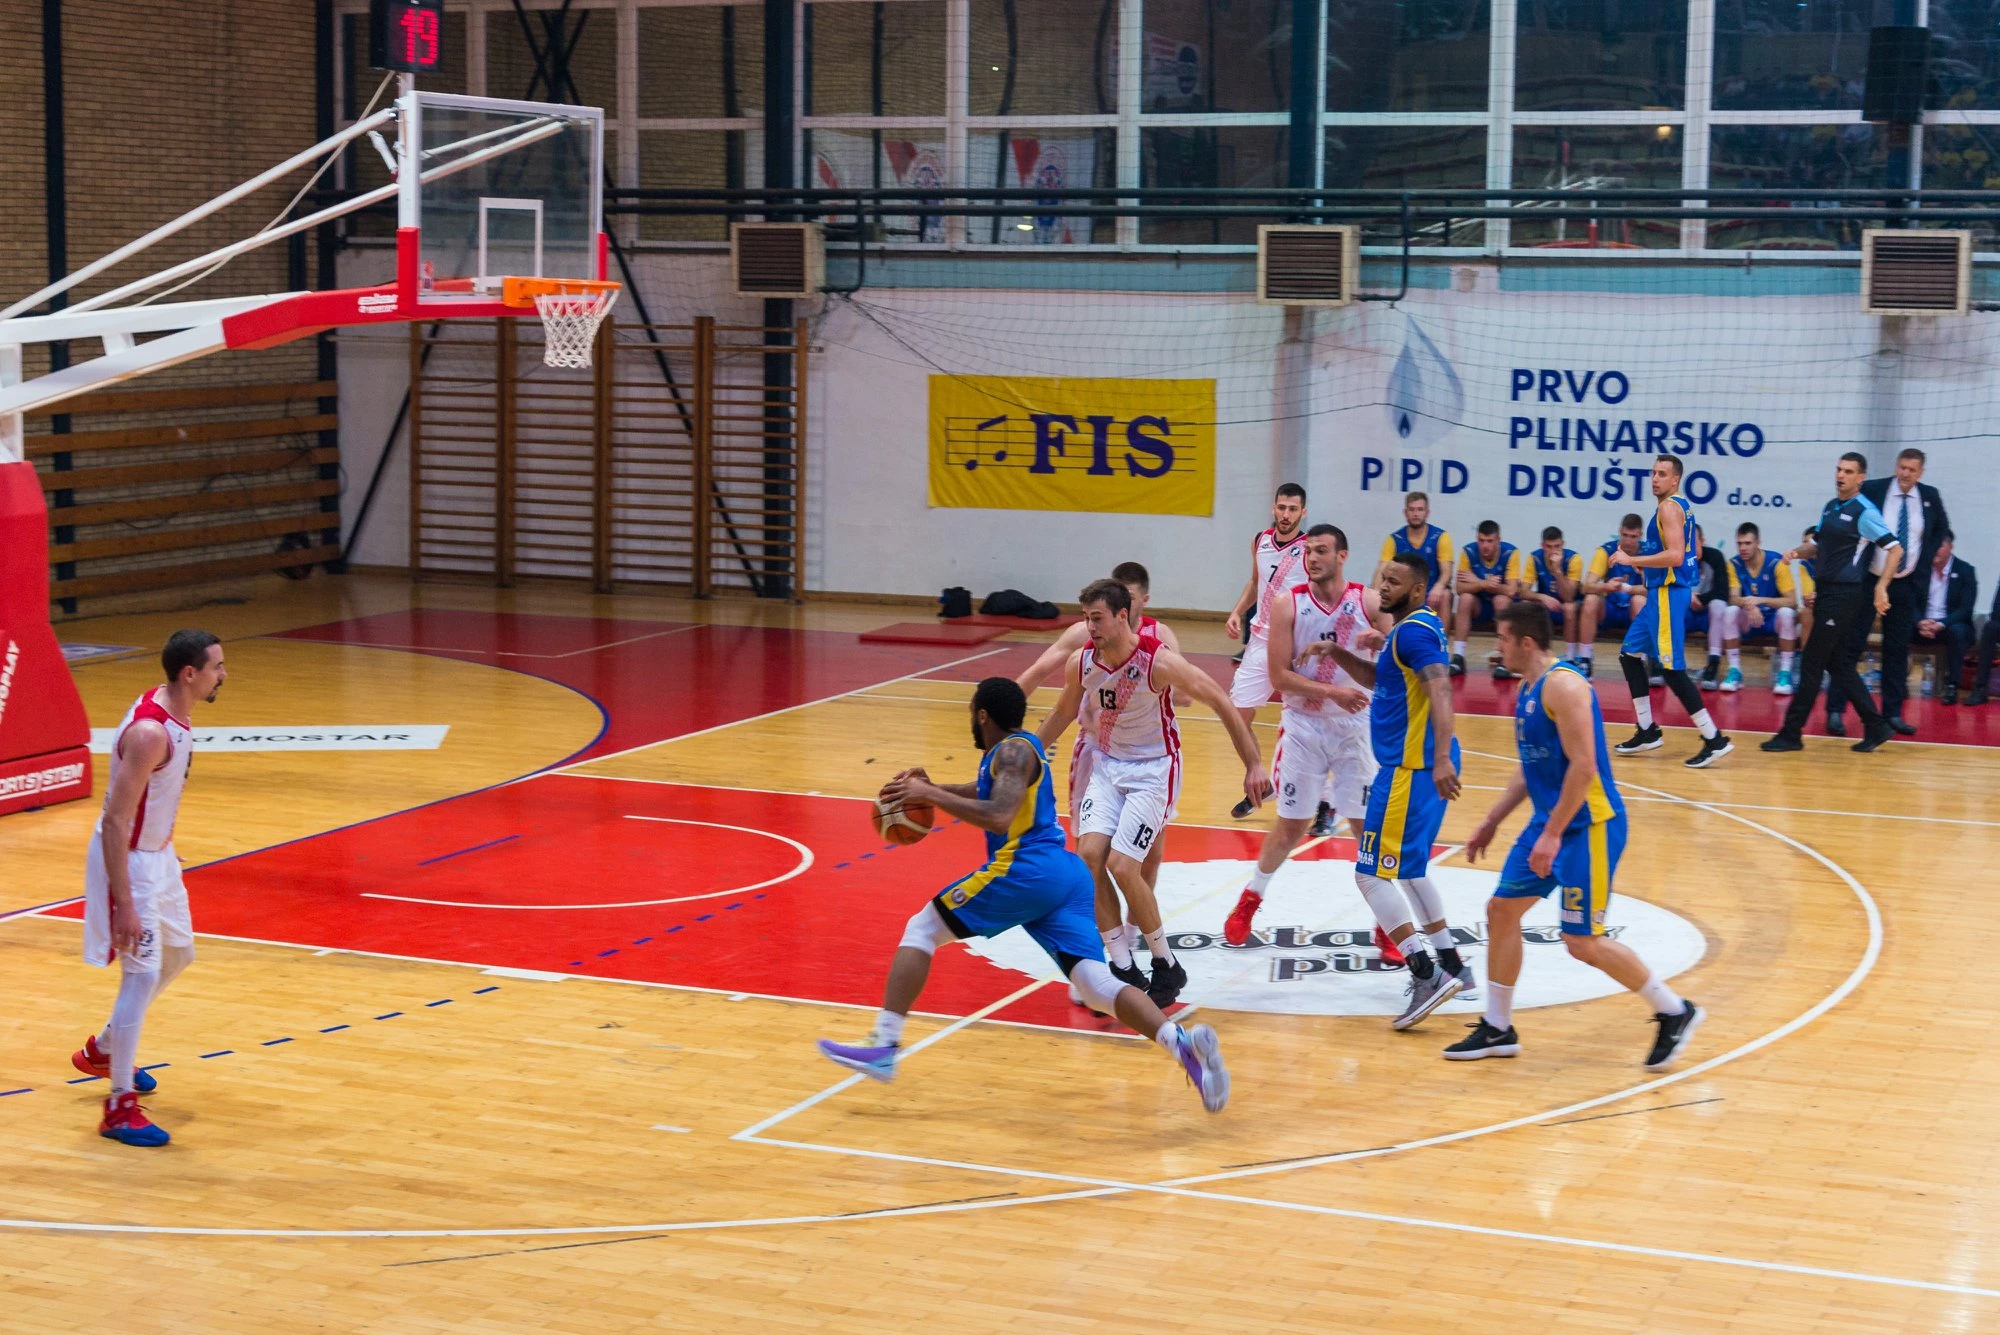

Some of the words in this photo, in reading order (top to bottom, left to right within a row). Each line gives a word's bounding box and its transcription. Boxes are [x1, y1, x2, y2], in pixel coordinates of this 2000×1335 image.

[400, 9, 438, 64] 19
[1511, 368, 1630, 405] PRVO
[1028, 413, 1175, 478] FIS
[1510, 416, 1764, 458] PLINARSKO
[1508, 458, 1718, 504] DRUŠTO
[1727, 487, 1792, 508] d.o.o.
[1268, 564, 1278, 582] 7
[1099, 688, 1117, 710] 13
[230, 734, 411, 742] MOSTAR
[1132, 823, 1153, 850] 13
[1362, 830, 1376, 853] 17
